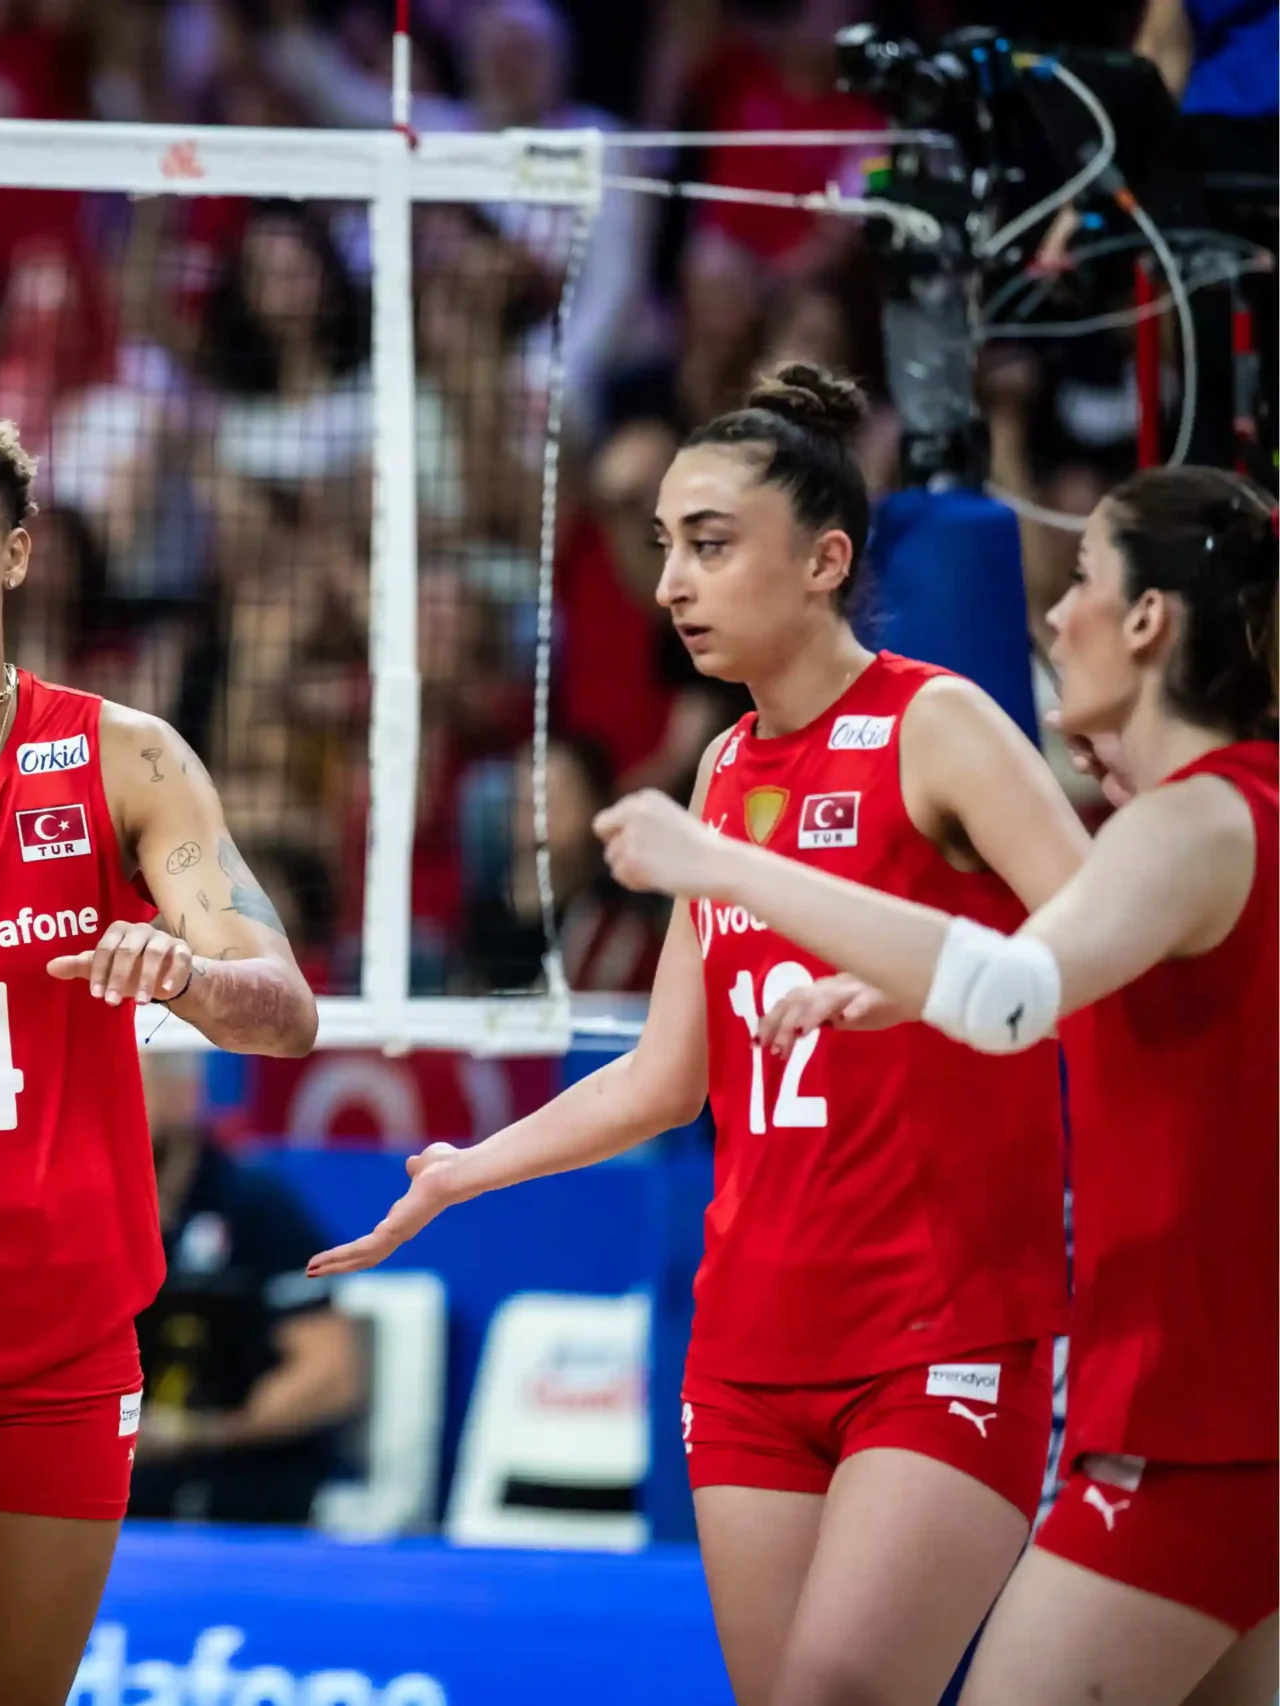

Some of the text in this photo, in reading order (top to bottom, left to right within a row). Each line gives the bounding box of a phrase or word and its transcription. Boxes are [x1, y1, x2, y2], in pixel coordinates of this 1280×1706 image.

[21, 736, 85, 772] Orkid
[812, 833, 843, 844] TUR
[38, 843, 74, 856] TUR
[729, 961, 828, 1135] 12
[933, 1371, 996, 1387] trendyol
